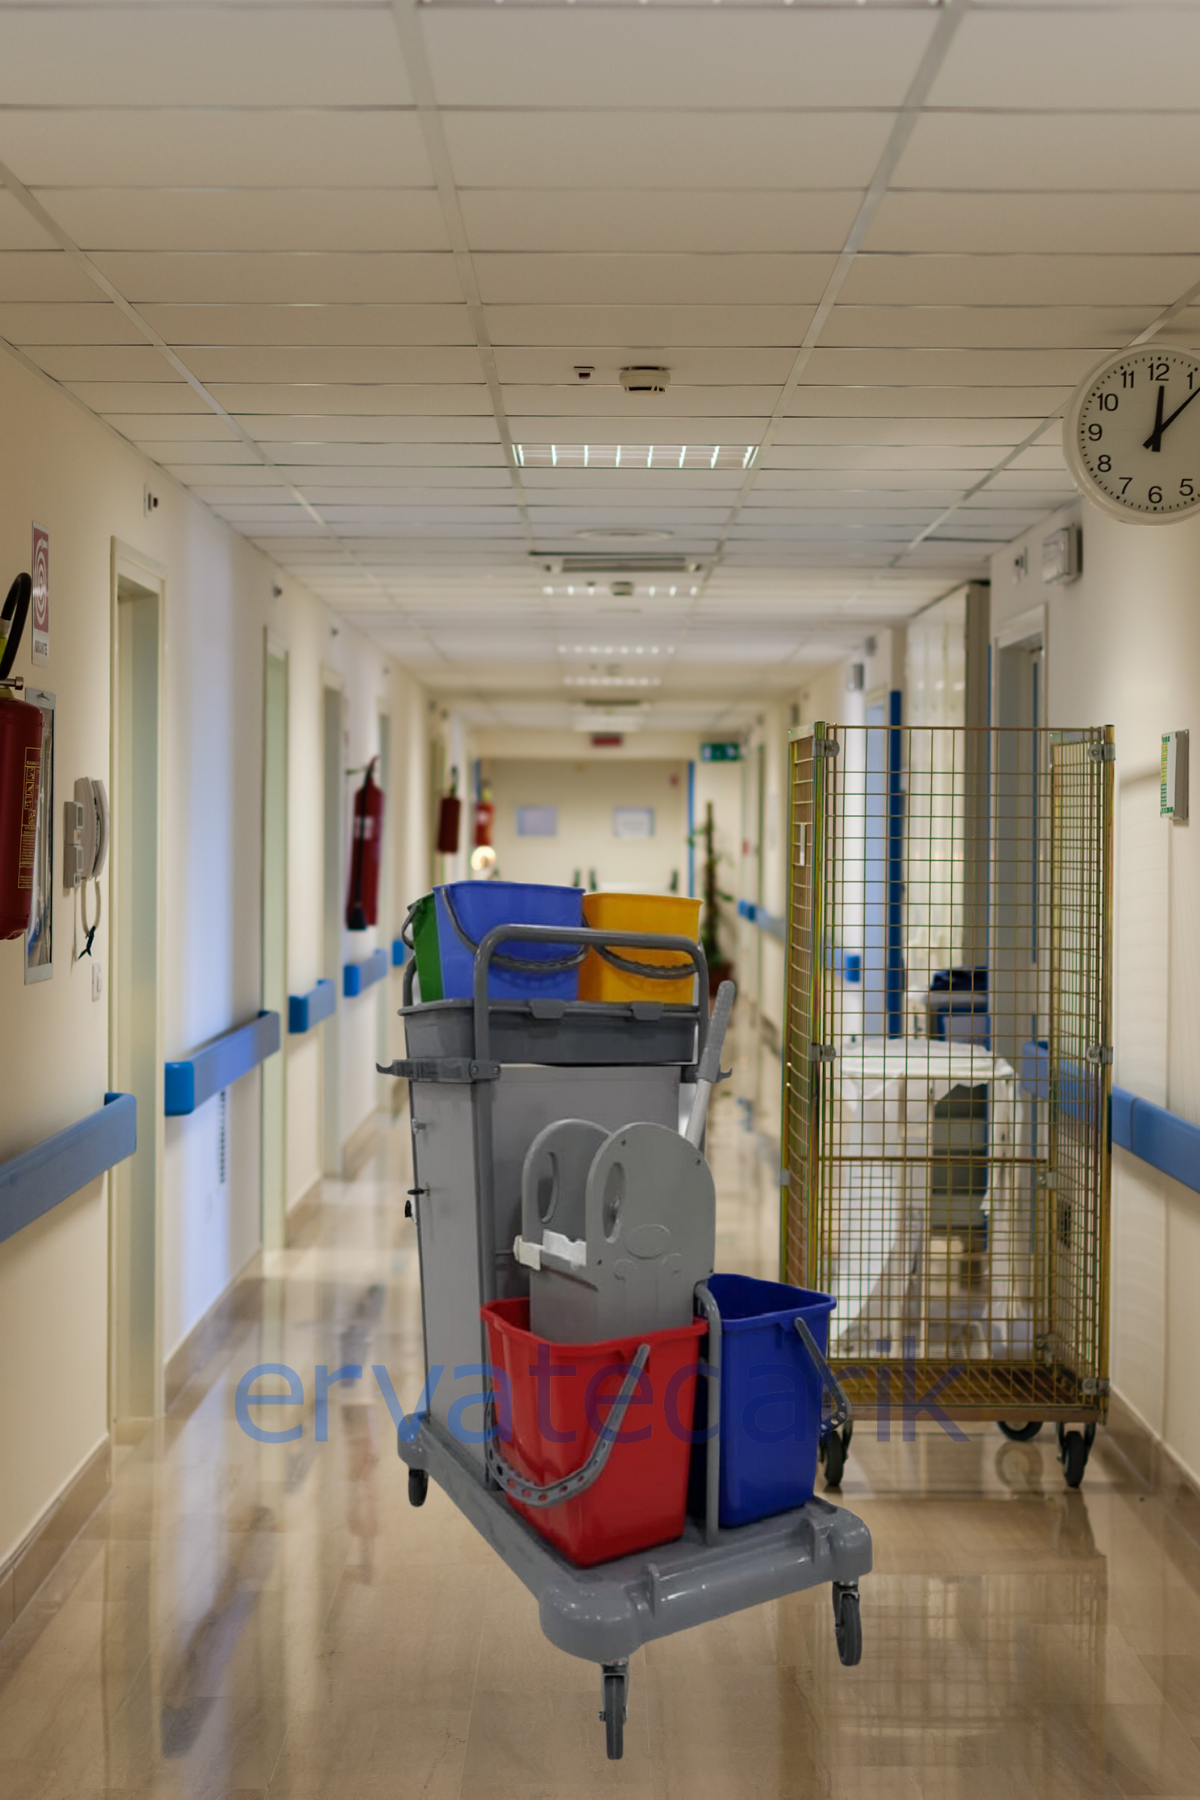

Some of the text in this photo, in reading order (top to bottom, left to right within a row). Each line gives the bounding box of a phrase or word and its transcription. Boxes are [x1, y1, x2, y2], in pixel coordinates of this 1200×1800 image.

[1121, 370, 1135, 388] 11
[1148, 363, 1169, 381] 12
[1187, 371, 1194, 389] 1
[1097, 393, 1119, 411] 10
[1088, 423, 1102, 441] 9
[1098, 454, 1112, 472] 8
[1119, 477, 1133, 494] 7
[1148, 486, 1163, 503] 6
[1179, 478, 1194, 496] 5
